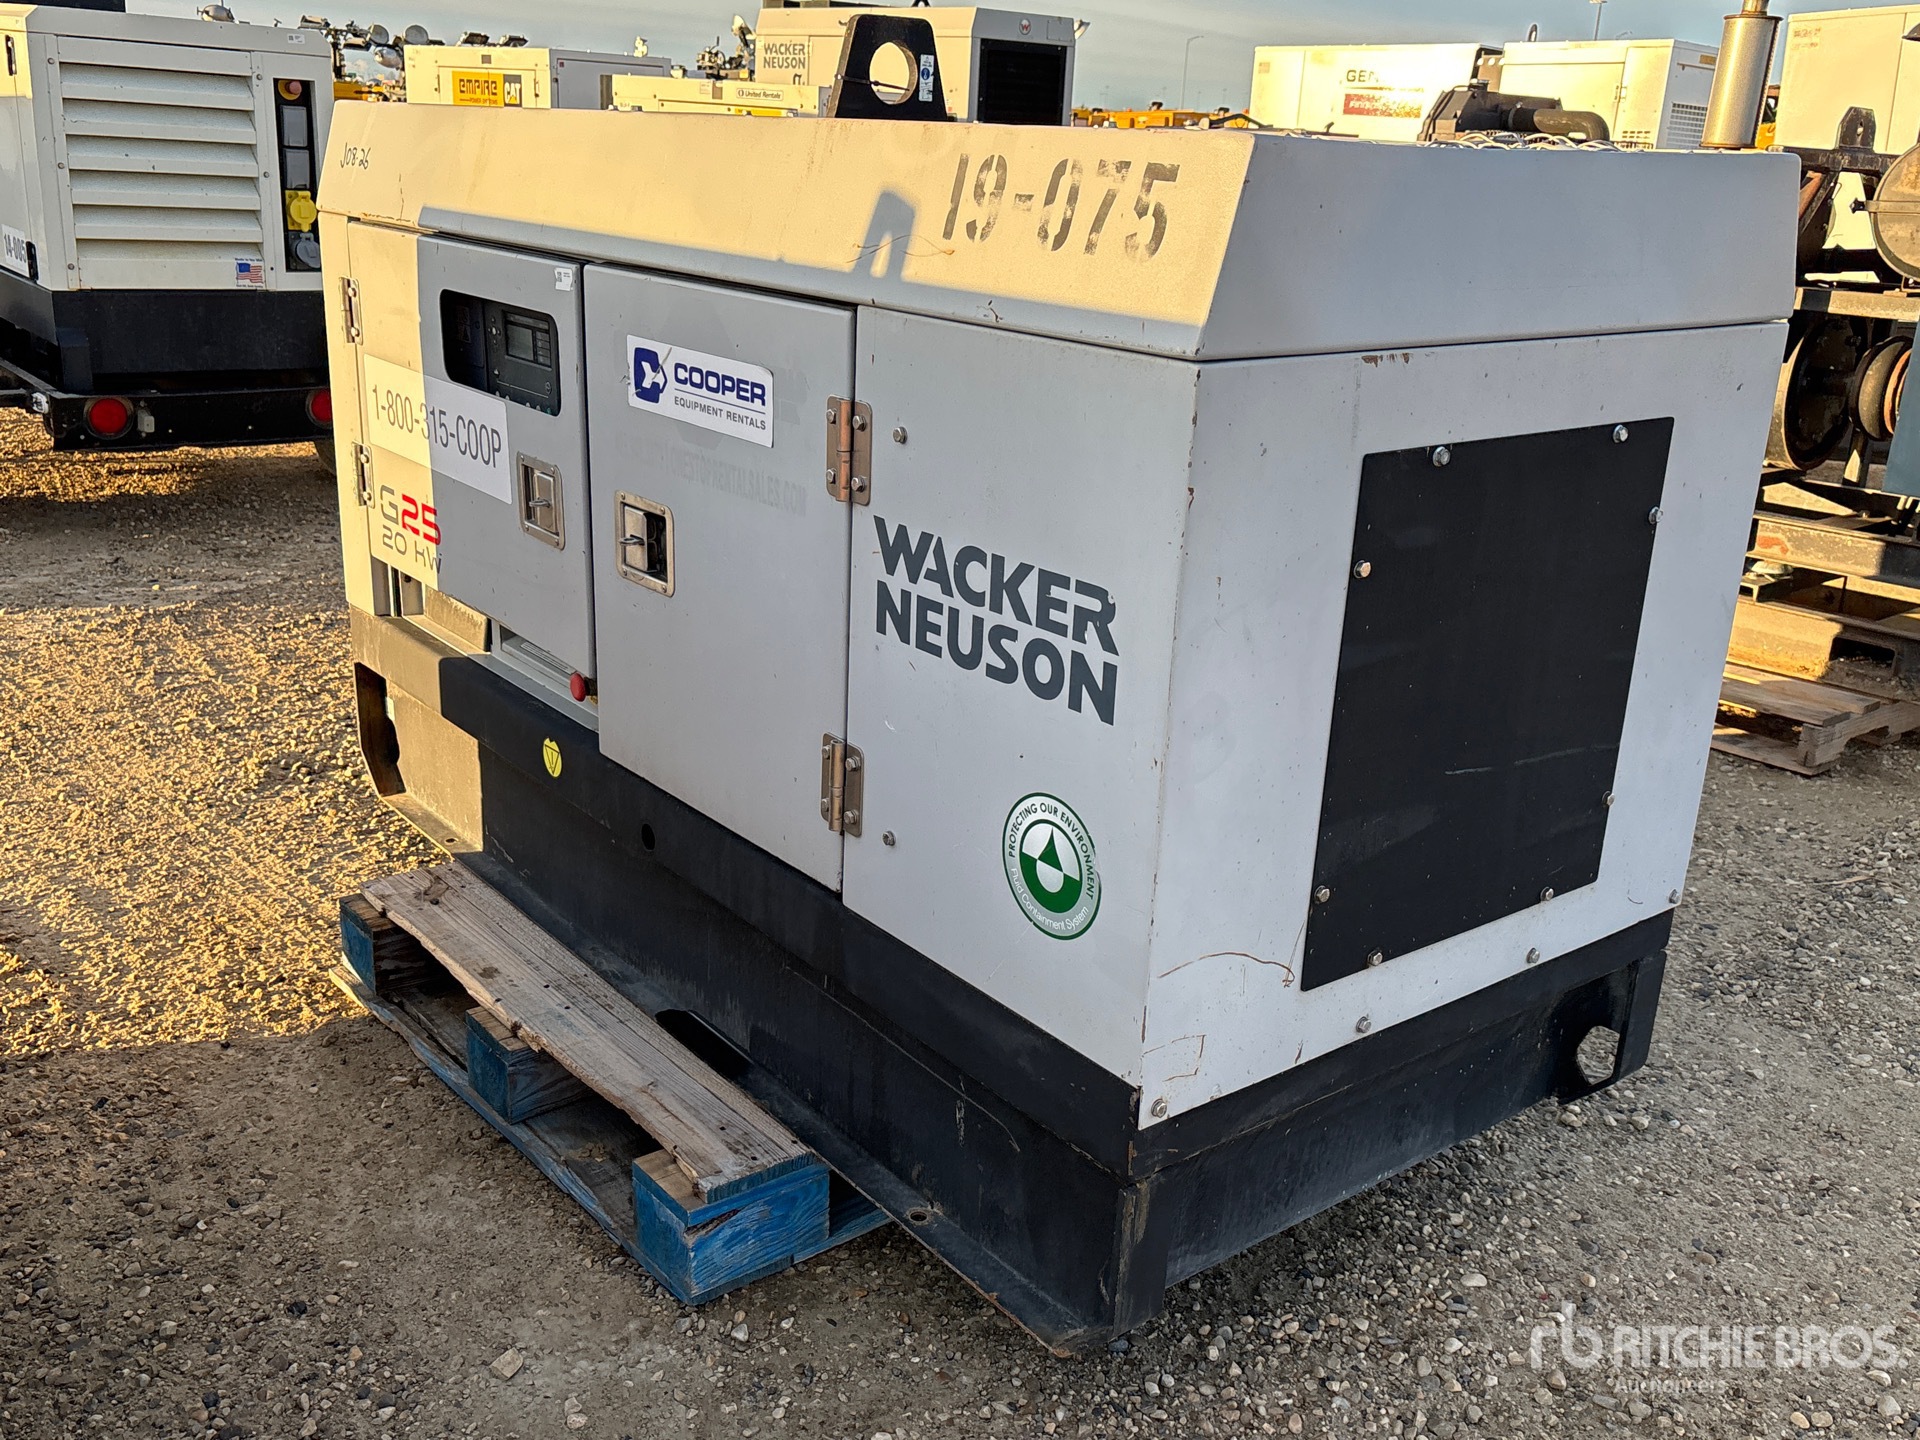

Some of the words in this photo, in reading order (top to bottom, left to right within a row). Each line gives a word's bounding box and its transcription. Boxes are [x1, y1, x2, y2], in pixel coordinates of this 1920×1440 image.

[763, 43, 806, 56] WACKER
[763, 56, 806, 69] NEUSON
[459, 78, 498, 96] EMPIRE
[504, 81, 521, 105] CAT
[745, 90, 762, 98] United
[762, 91, 782, 99] Rentals
[942, 152, 1180, 262] 19-075
[674, 362, 766, 407] COOPER
[372, 383, 502, 469] 1-800-315-COOP
[674, 396, 723, 418] EQUIPMENT
[726, 410, 767, 430] RENTALS
[380, 484, 442, 546] G25
[382, 524, 408, 556] 20
[873, 514, 1120, 657] WACKER
[876, 579, 1118, 726] NEUSON
[1008, 803, 1038, 858] PROTECTING
[1039, 802, 1059, 818] OUR
[1060, 812, 1096, 900] ENVIRONMENT
[1011, 868, 1025, 894] Fluid
[1021, 893, 1066, 931] Containment
[1065, 906, 1089, 931] System
